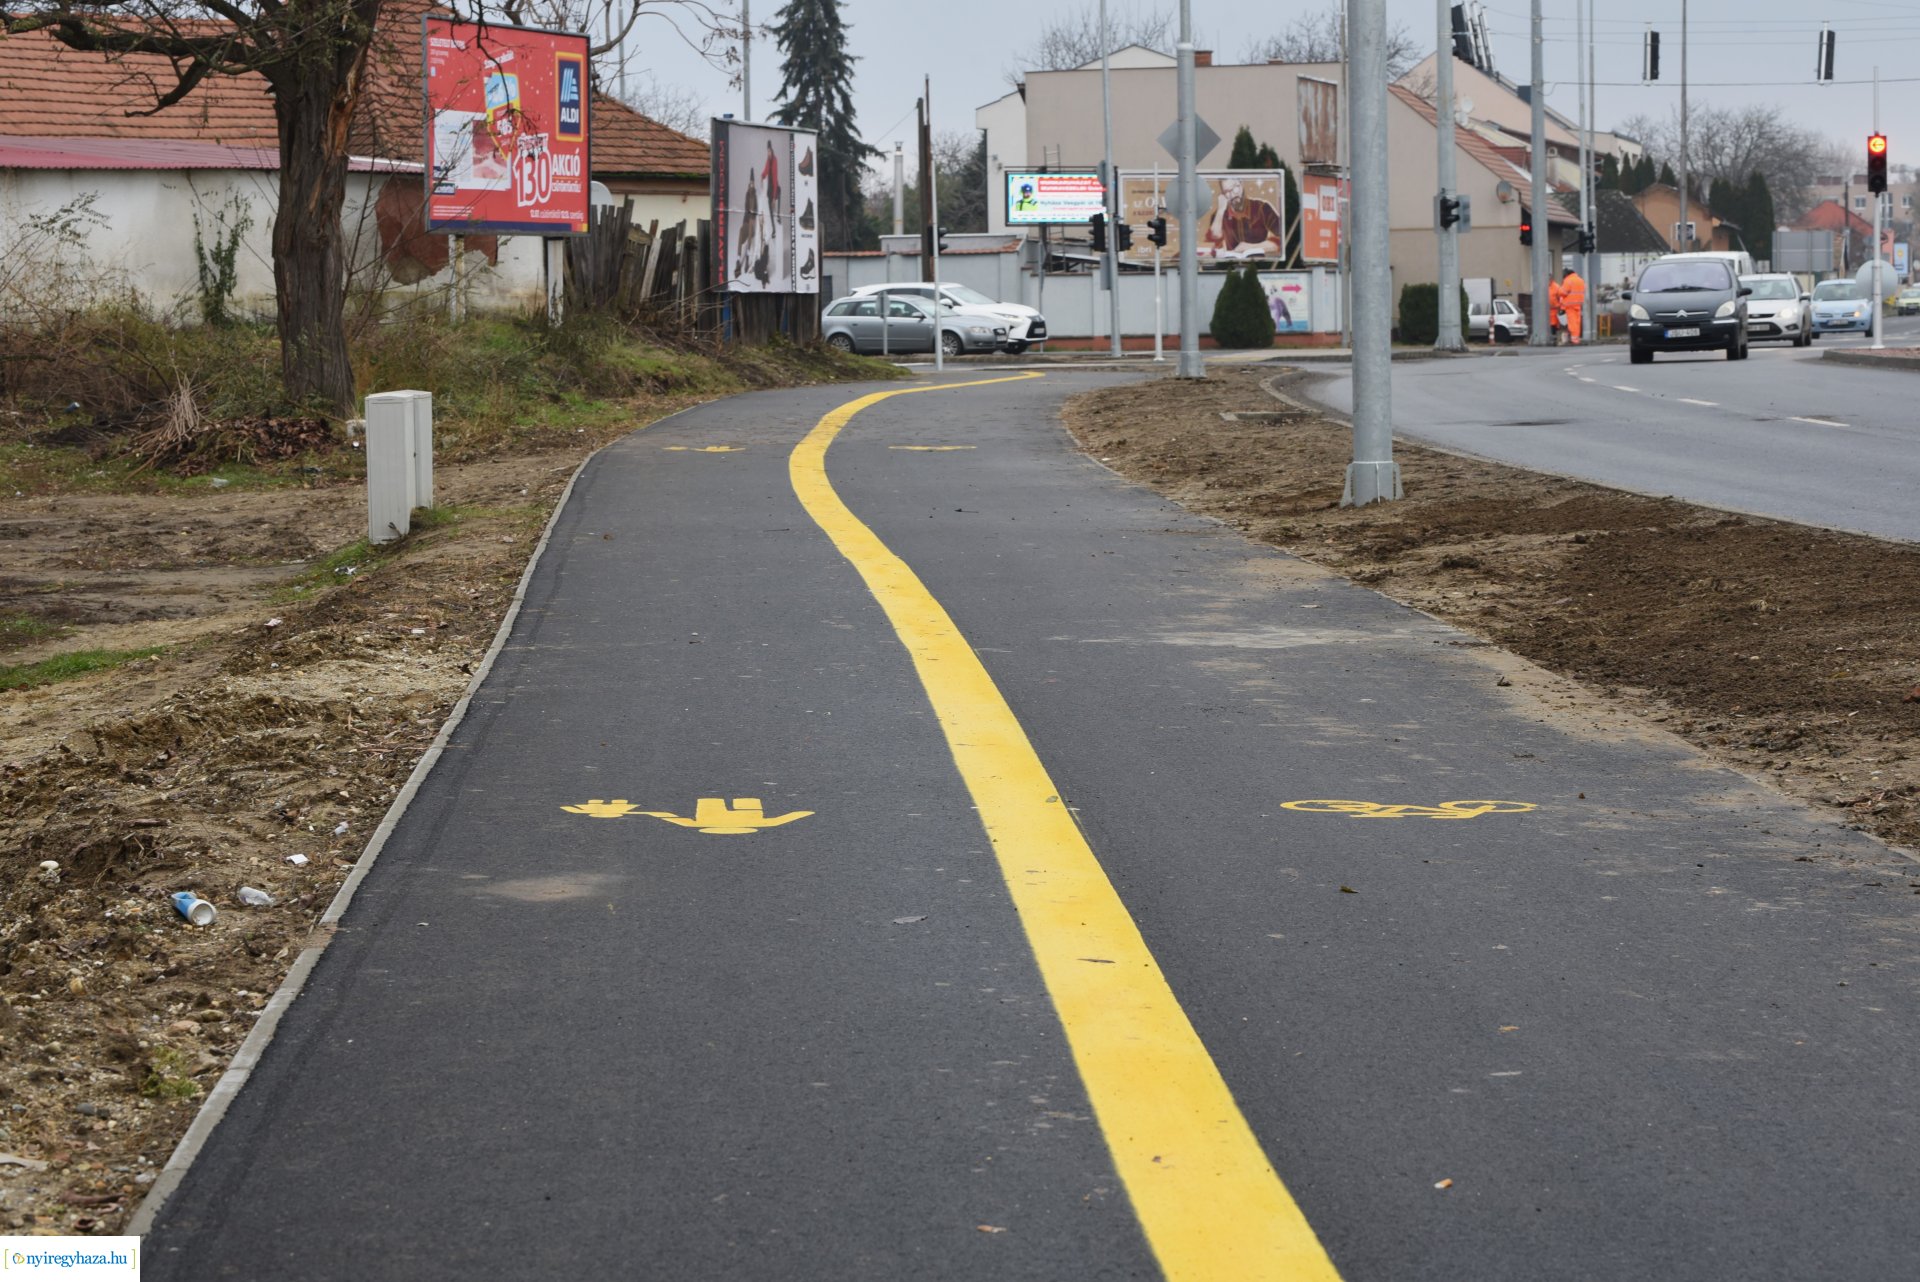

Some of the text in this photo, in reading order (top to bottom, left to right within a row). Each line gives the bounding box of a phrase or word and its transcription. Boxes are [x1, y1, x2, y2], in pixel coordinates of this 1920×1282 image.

[560, 107, 579, 123] ALDI
[552, 147, 581, 177] AKCIÓ
[512, 150, 552, 207] 130
